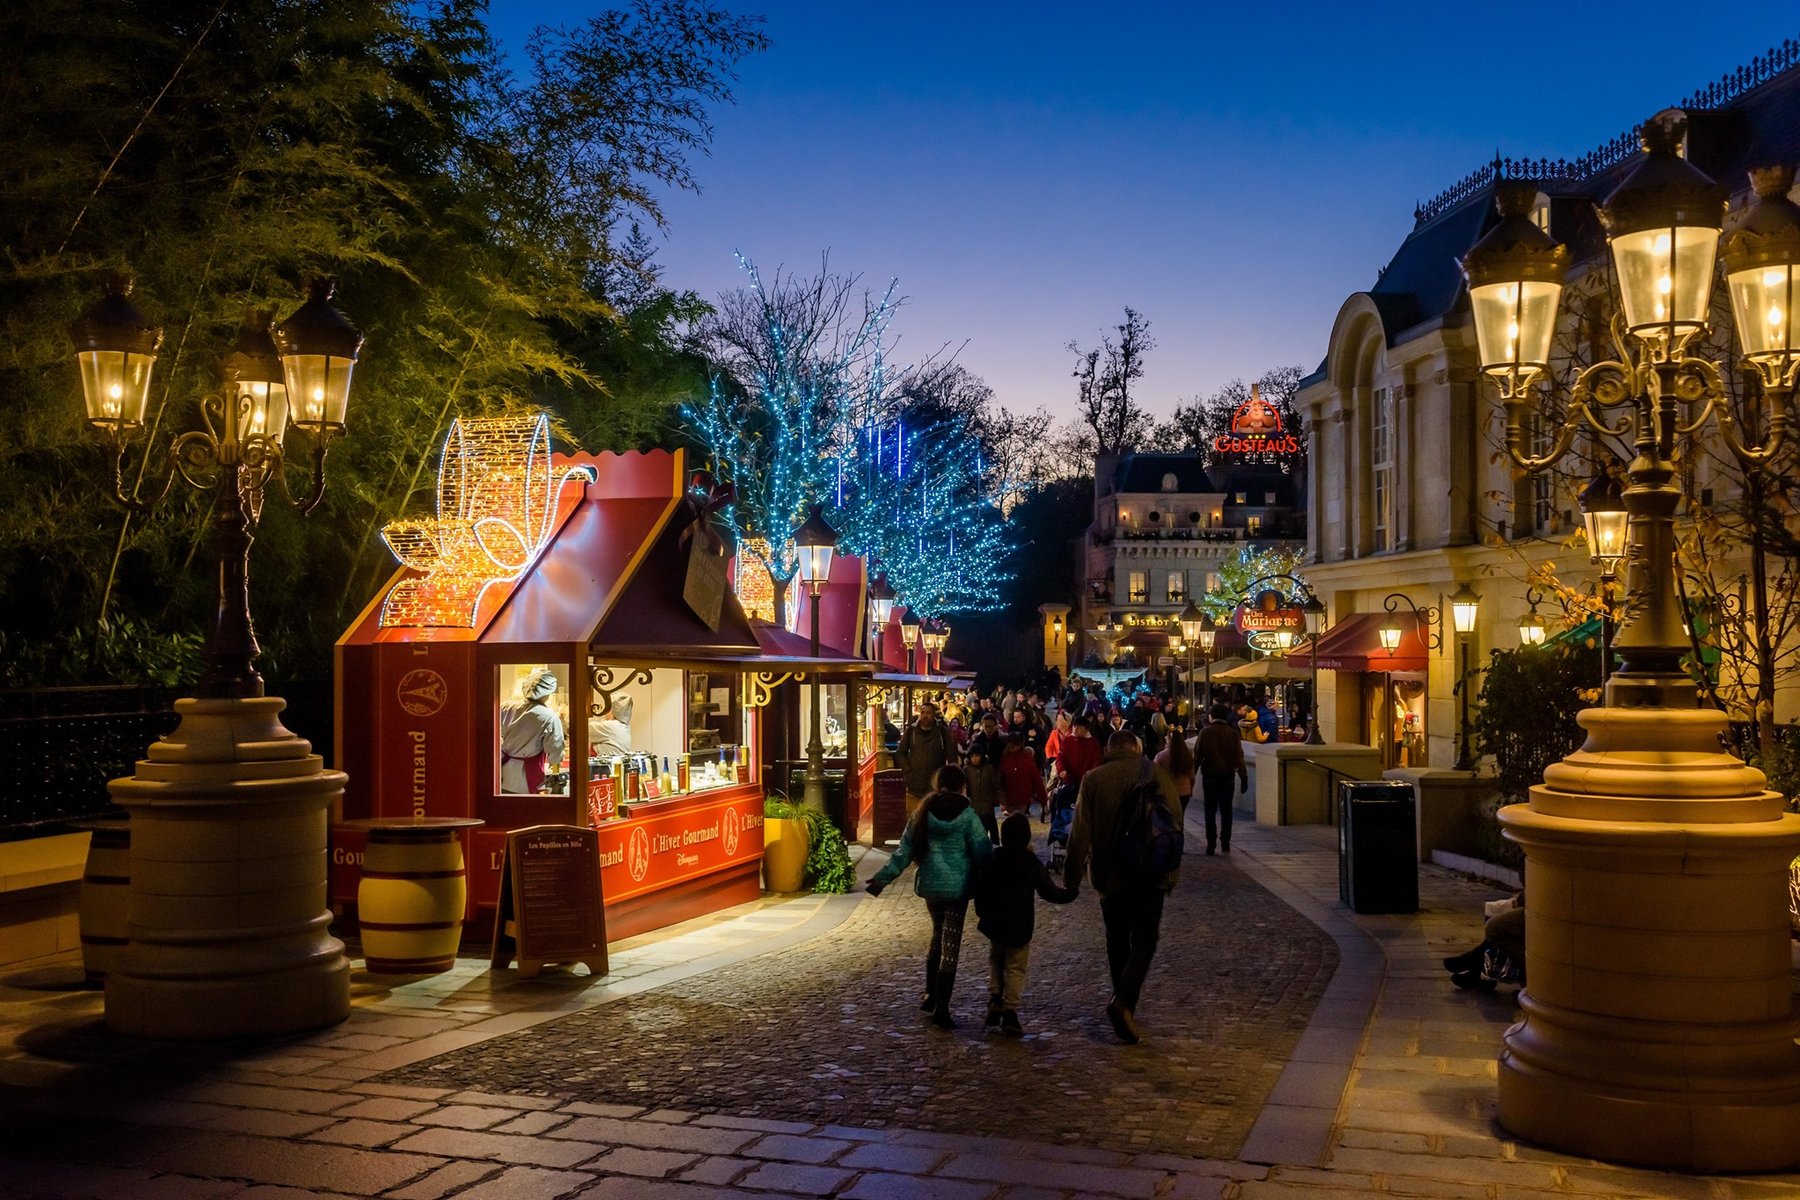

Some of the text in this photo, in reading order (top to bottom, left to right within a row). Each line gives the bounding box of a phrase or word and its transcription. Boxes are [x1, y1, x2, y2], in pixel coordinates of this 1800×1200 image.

[1215, 434, 1298, 453] GUSTEAU'S
[1129, 618, 1170, 626] BISTROT
[408, 729, 427, 819] ourmand
[599, 842, 623, 868] mand
[652, 832, 681, 855] L'Hiver
[682, 821, 720, 847] Gourmand
